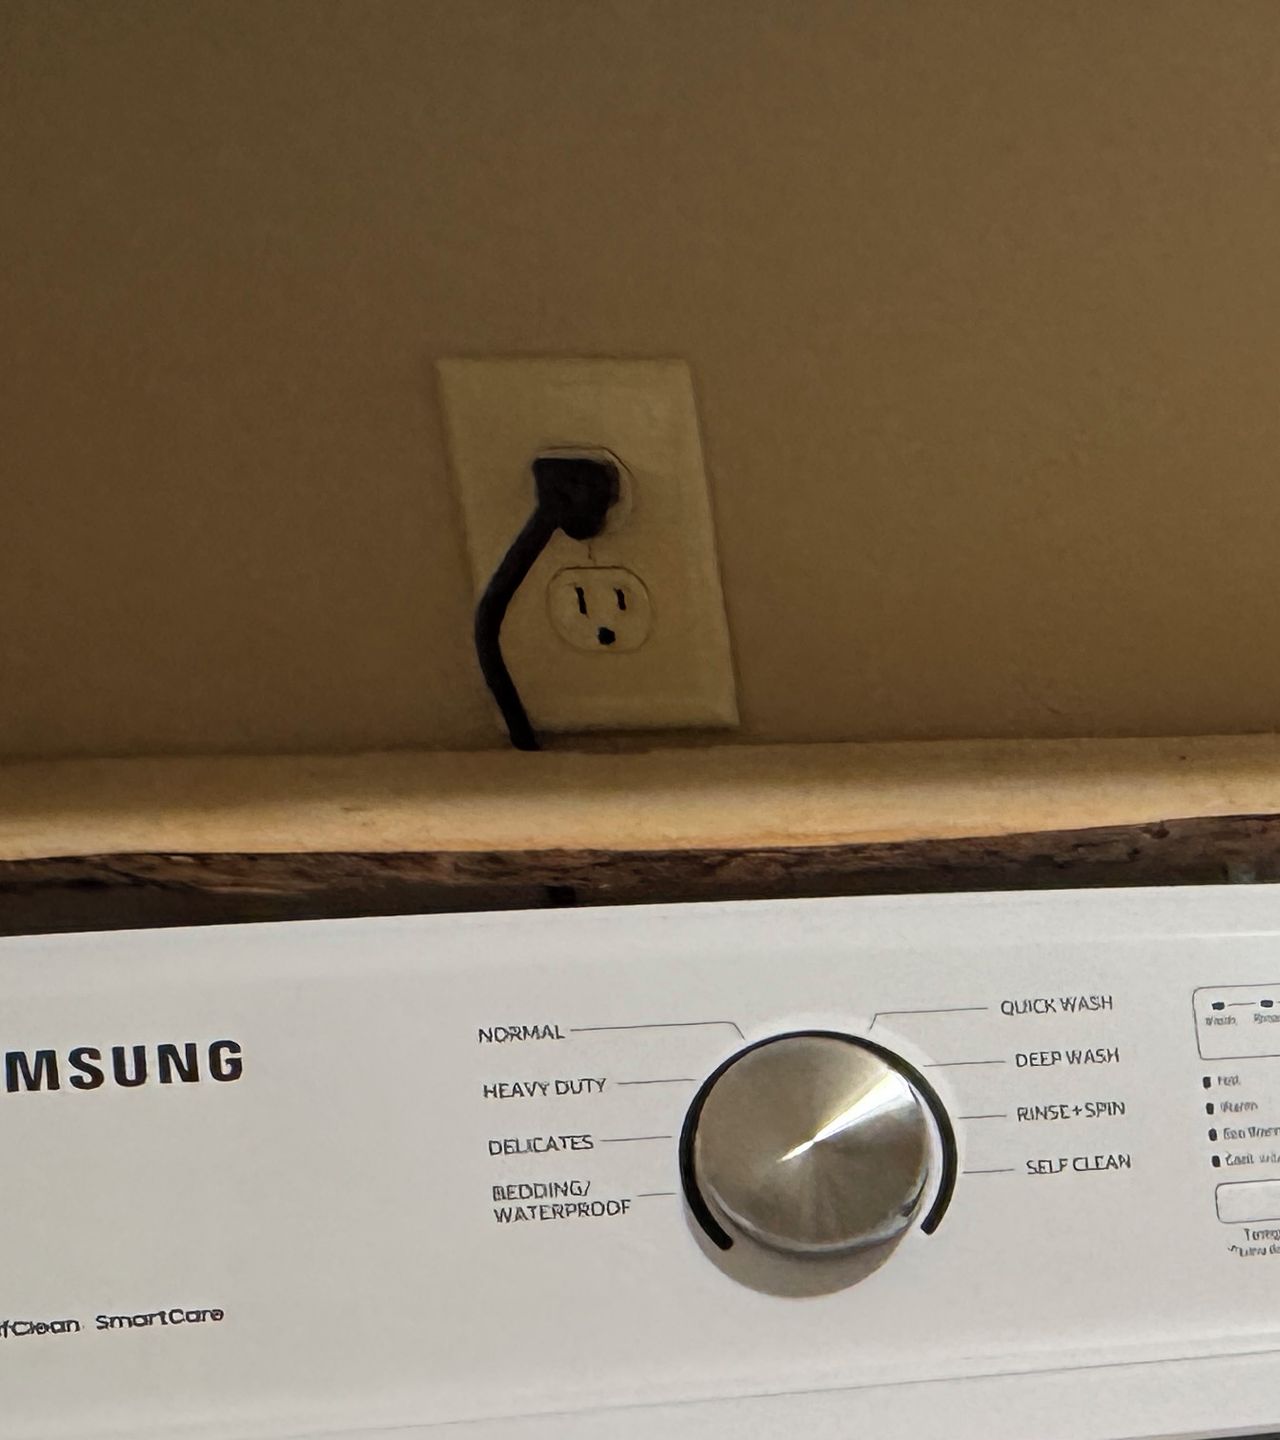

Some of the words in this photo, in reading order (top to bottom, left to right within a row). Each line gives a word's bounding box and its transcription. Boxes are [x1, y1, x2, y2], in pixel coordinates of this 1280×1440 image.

[1000, 999, 1057, 1016] QUICK
[1061, 995, 1113, 1013] WASH
[478, 1025, 565, 1043] NORMAL
[5, 1040, 243, 1092] MSUNG
[1015, 1051, 1062, 1068] DEEP
[1065, 1048, 1120, 1065] WASH
[483, 1081, 549, 1099] HEAVY
[555, 1078, 606, 1096] DUTY
[488, 1135, 594, 1156] DELICATES
[1026, 1158, 1068, 1175] SELF
[1072, 1154, 1132, 1171] CLEAN
[492, 1181, 590, 1201] BEDDING/
[494, 1200, 631, 1223] WATERPROOF
[96, 1308, 224, 1330] SmartCare
